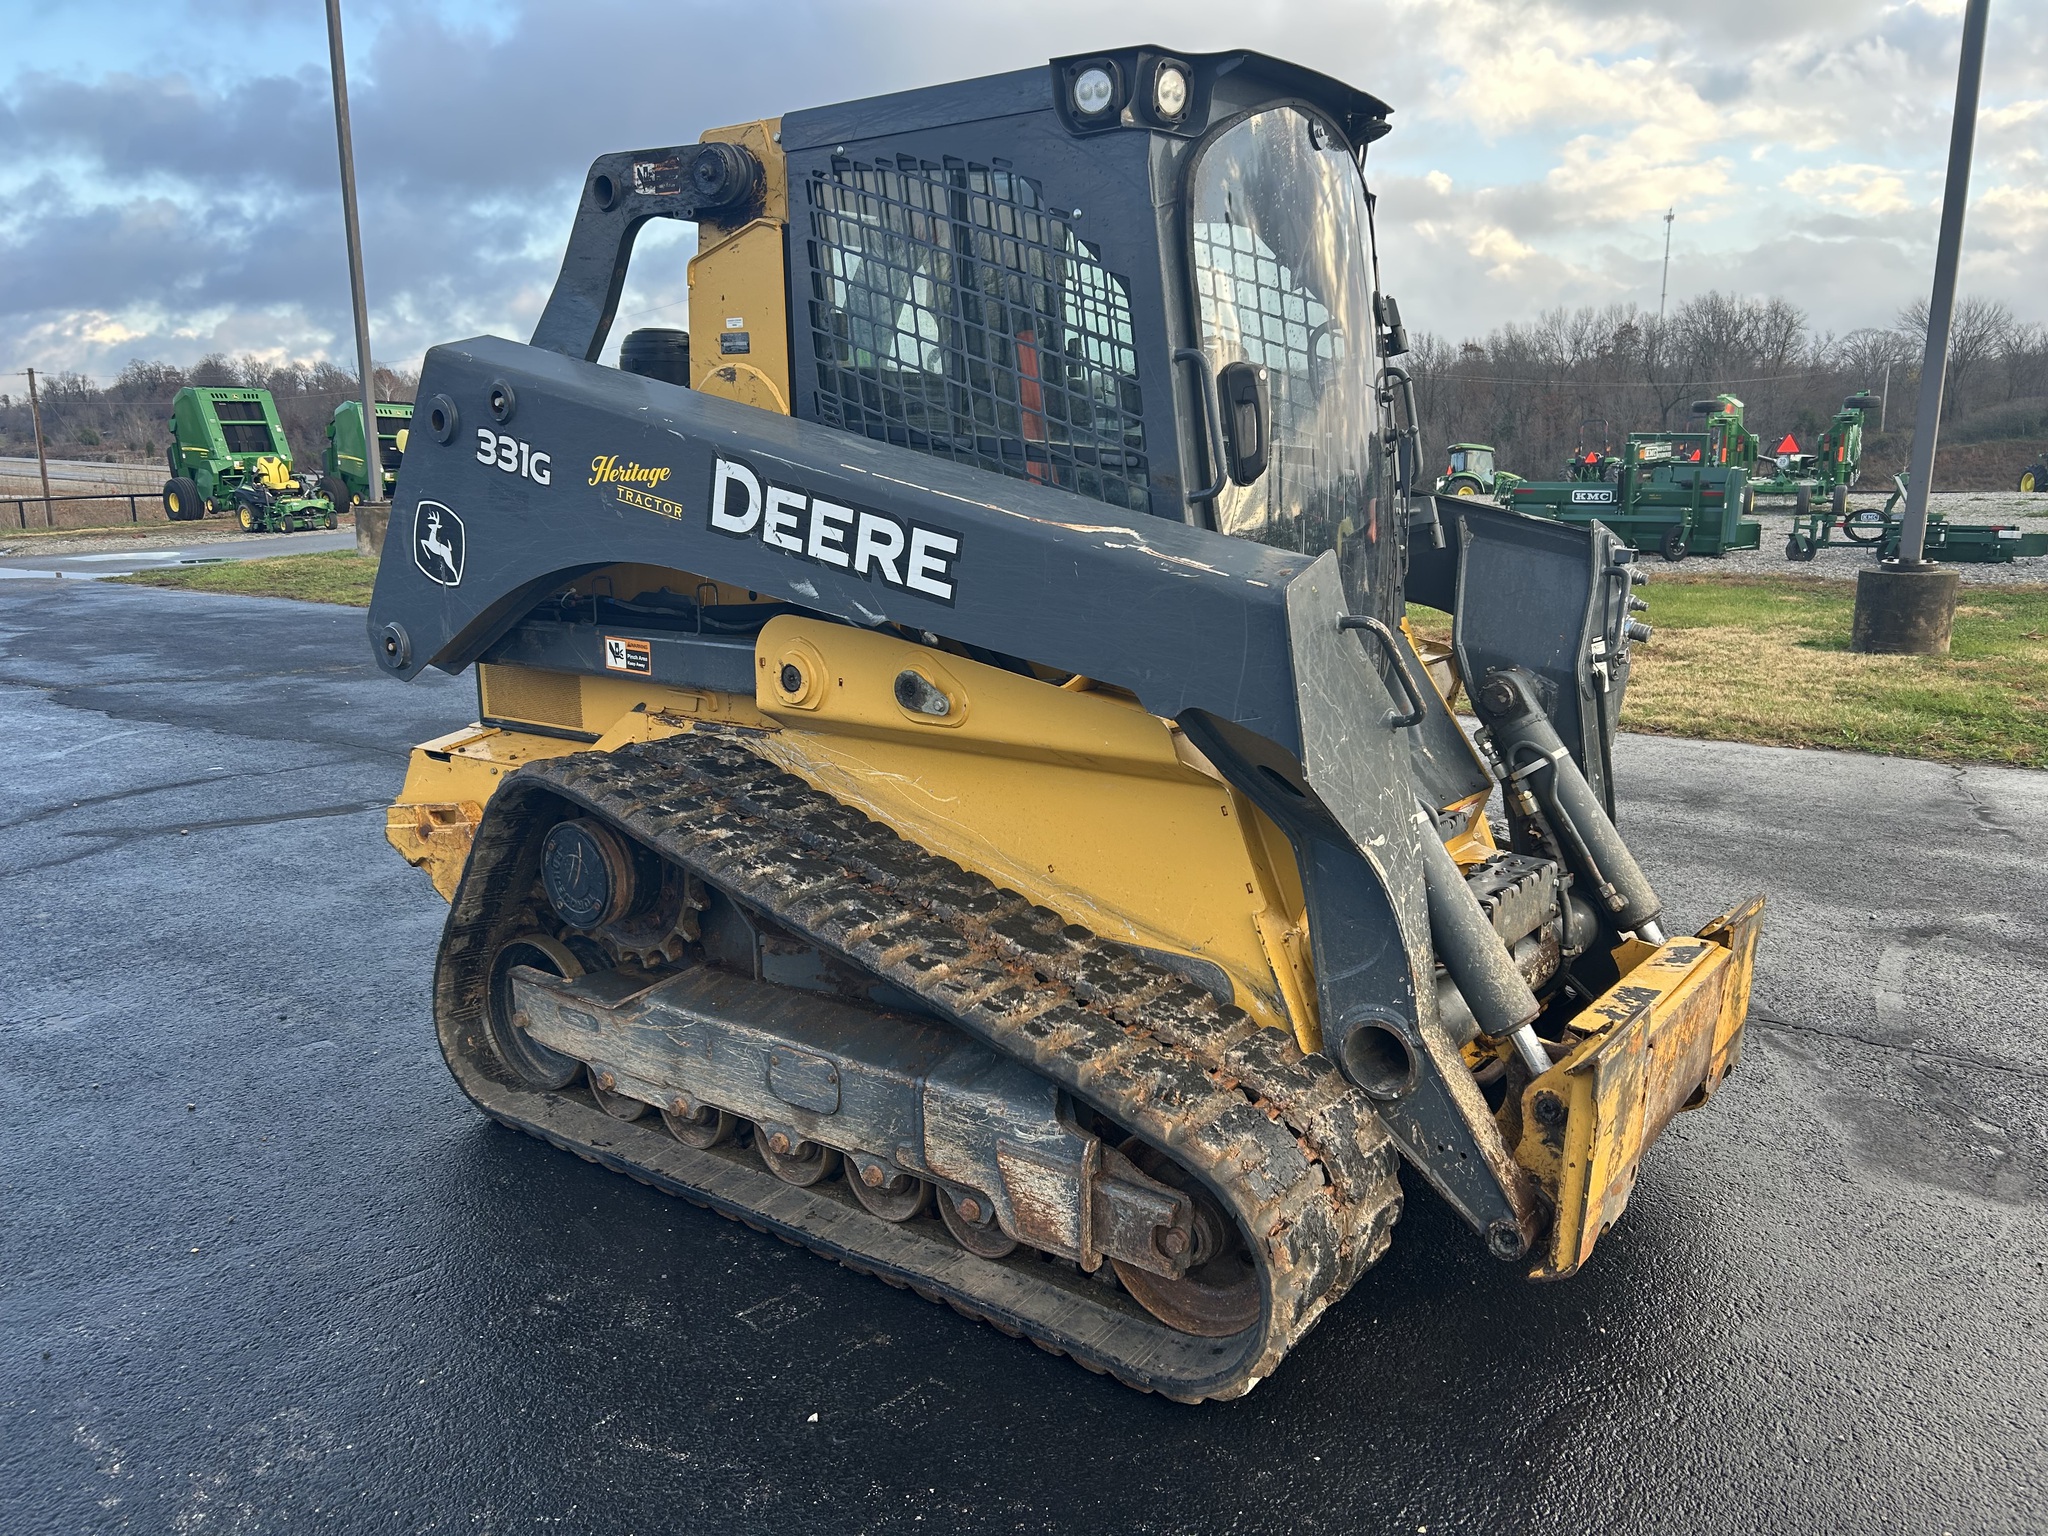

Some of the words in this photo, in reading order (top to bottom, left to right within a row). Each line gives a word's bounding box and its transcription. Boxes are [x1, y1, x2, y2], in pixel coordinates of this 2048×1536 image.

[476, 428, 551, 486] 331G
[588, 454, 671, 489] Heritage
[617, 486, 683, 518] TRACTOR
[1574, 492, 1610, 501] KMC
[711, 458, 958, 600] DEERE
